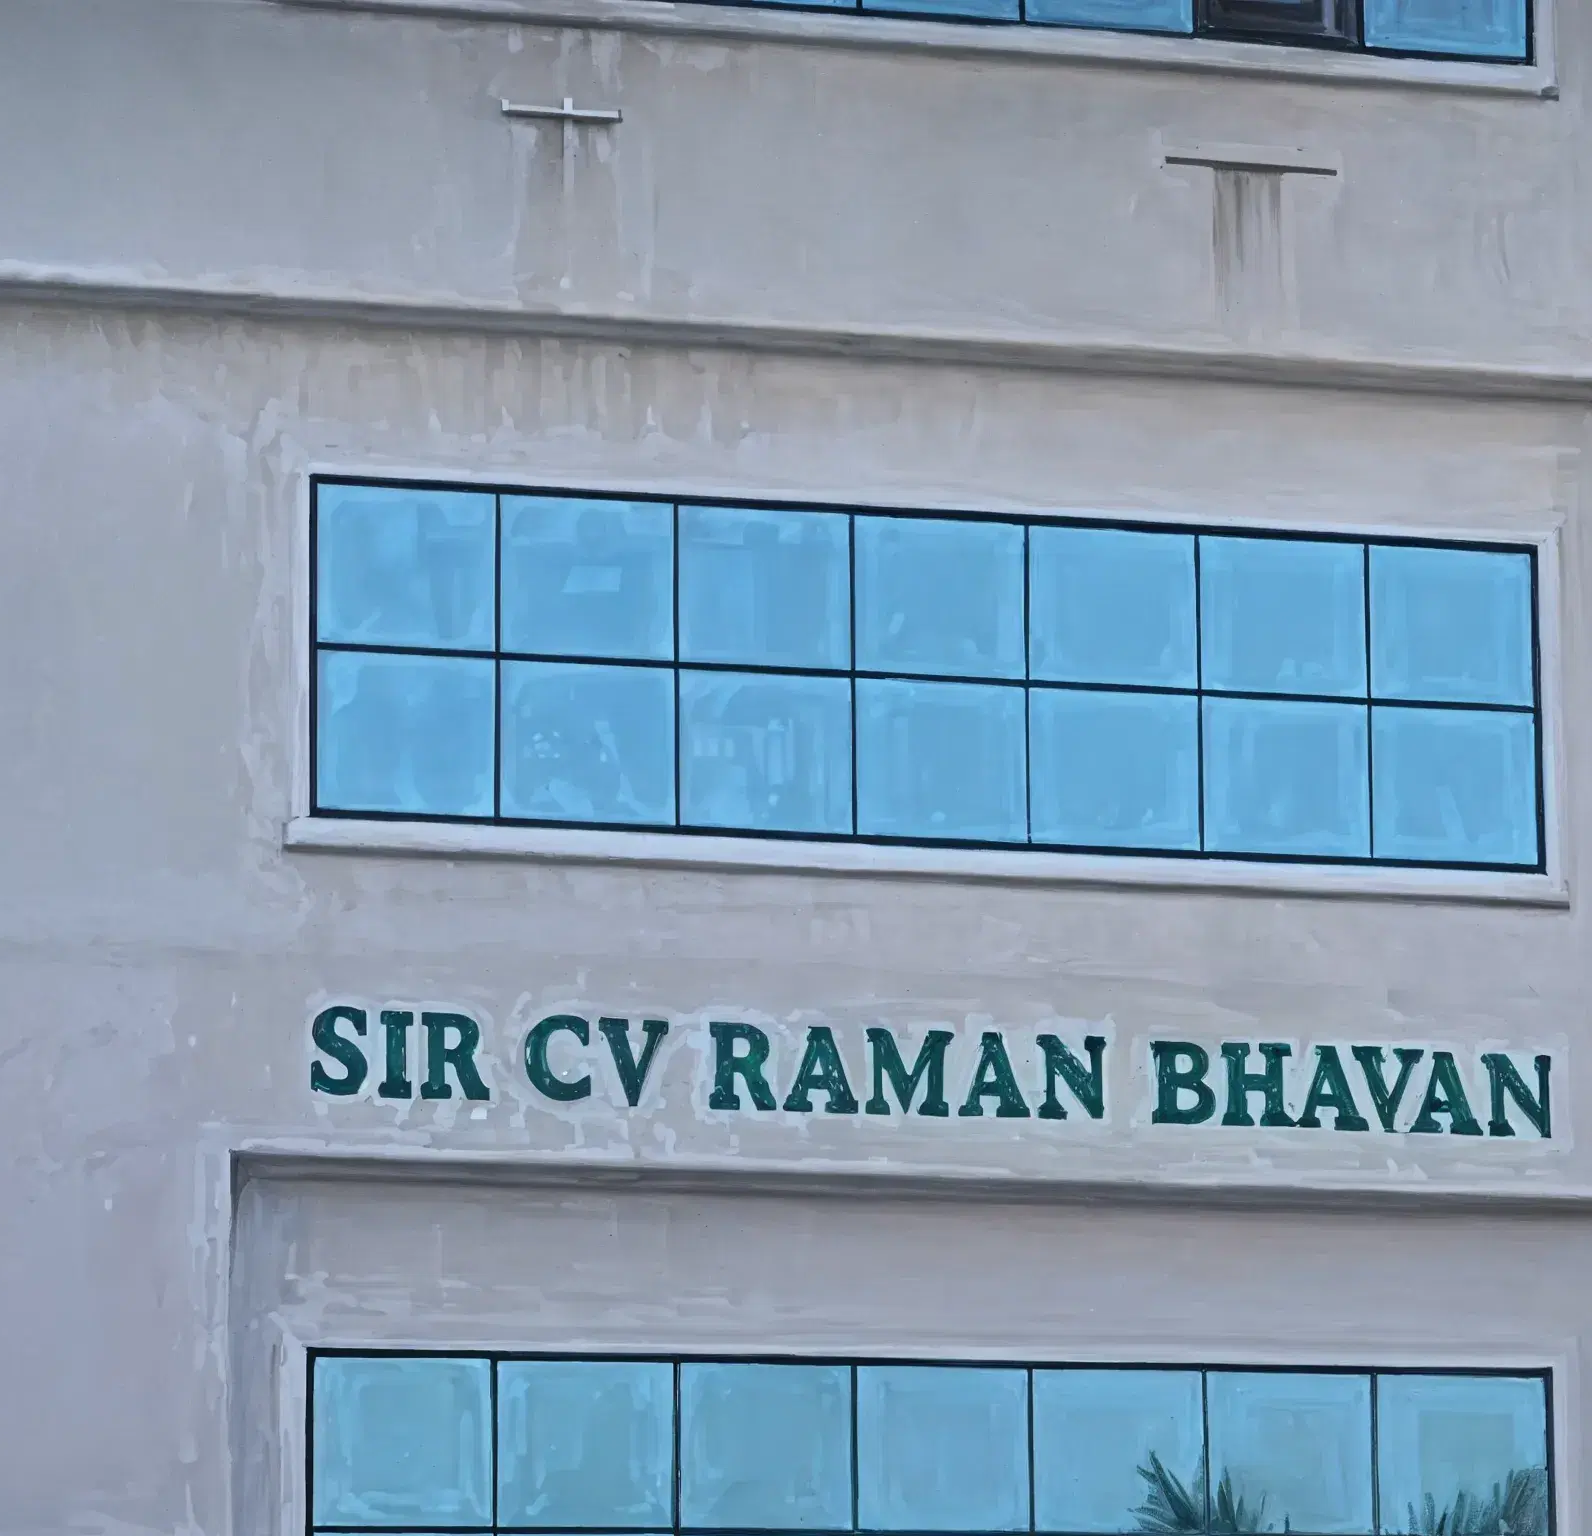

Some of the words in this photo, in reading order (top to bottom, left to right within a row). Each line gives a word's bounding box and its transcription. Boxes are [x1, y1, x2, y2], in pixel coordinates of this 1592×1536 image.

[310, 1005, 491, 1101] SIR
[524, 1014, 670, 1107] CV
[708, 1021, 1107, 1121] RAMAN
[1149, 1040, 1552, 1139] BHAVAN
